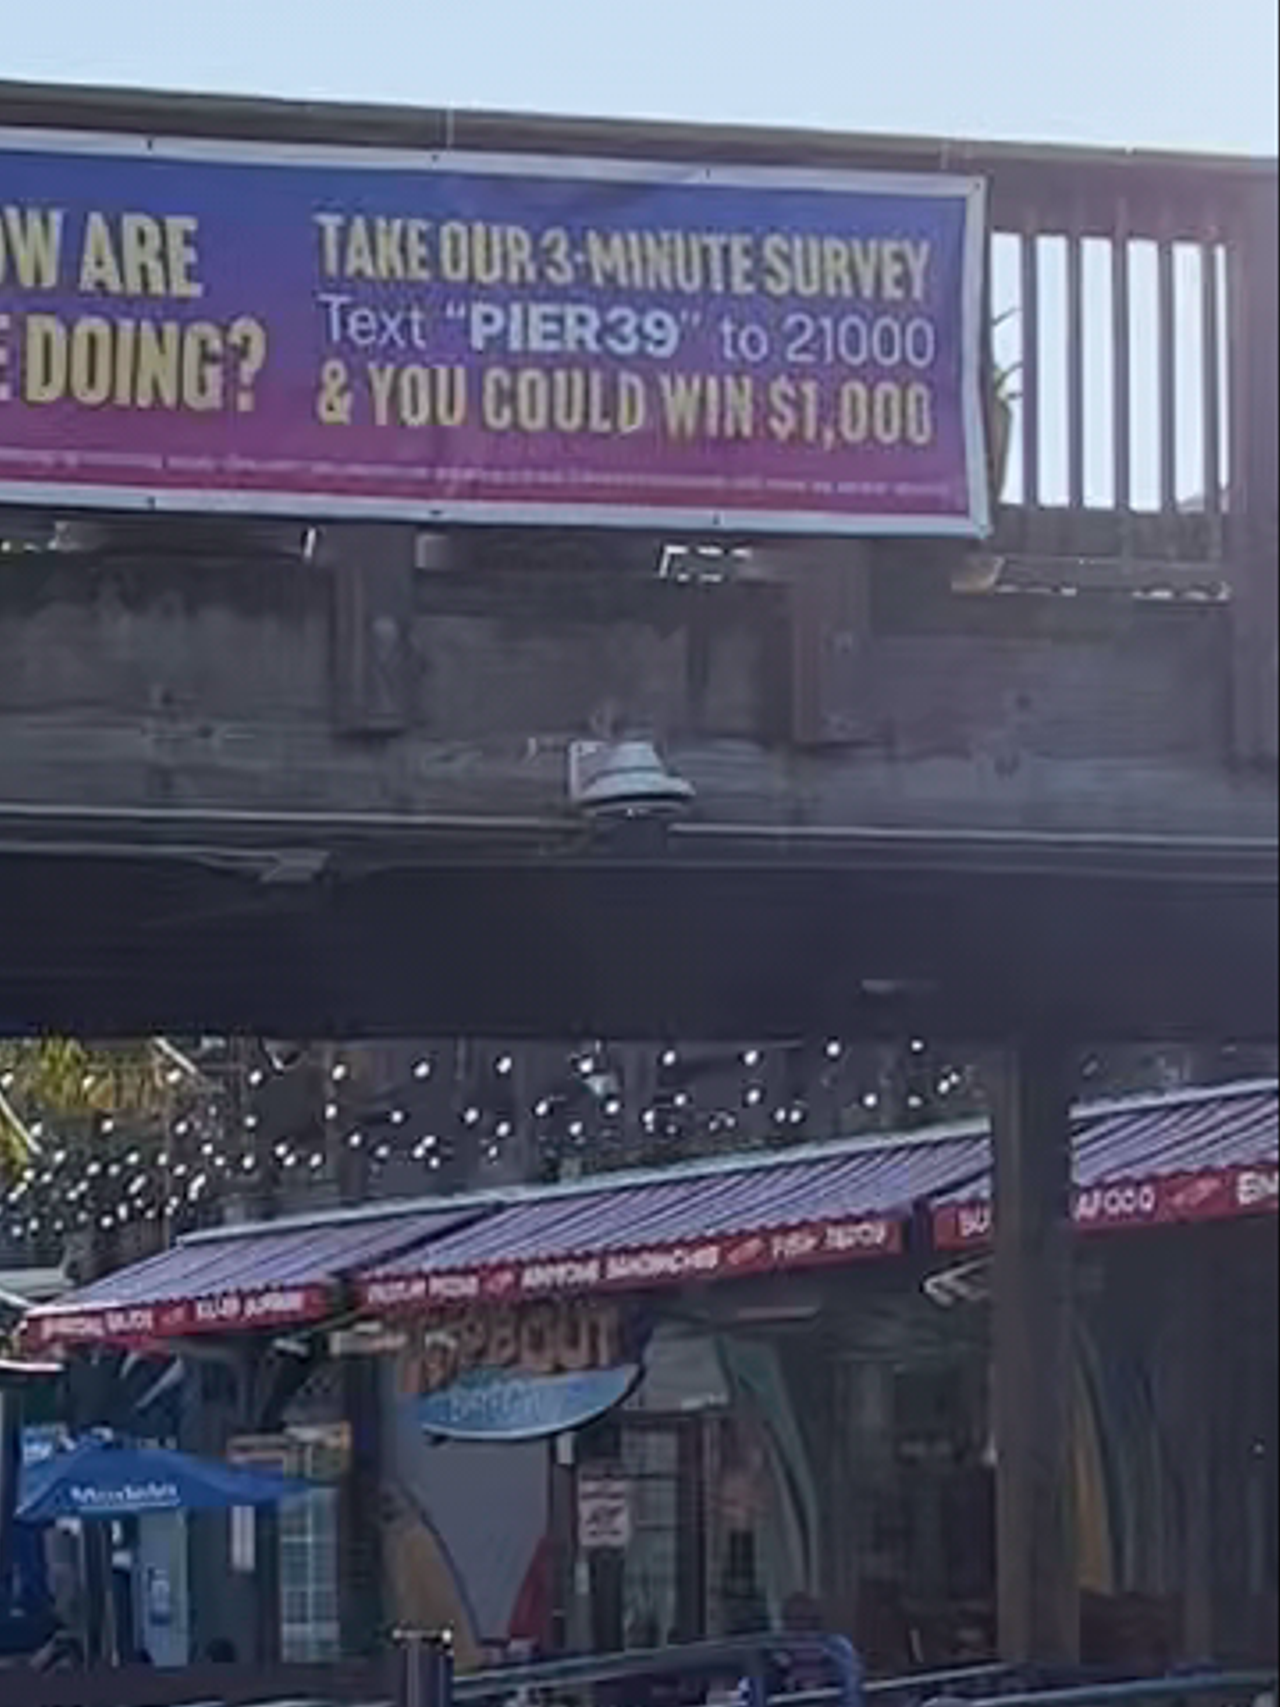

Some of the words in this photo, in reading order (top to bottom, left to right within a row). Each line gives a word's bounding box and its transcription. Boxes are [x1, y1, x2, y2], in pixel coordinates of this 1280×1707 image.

[79, 211, 204, 298] ARE
[313, 213, 432, 281] TAKE
[440, 221, 537, 284] OUR
[542, 225, 757, 293] 3-MINUTE
[762, 233, 931, 300] SURVEY
[24, 313, 267, 412] DOING?
[316, 294, 426, 349] Text
[721, 315, 769, 362] to
[783, 313, 936, 368] 21000
[317, 359, 353, 426] &
[368, 361, 467, 427] YOU
[482, 366, 645, 435] COULD
[659, 373, 754, 440] WIN
[768, 375, 932, 451] $1,000
